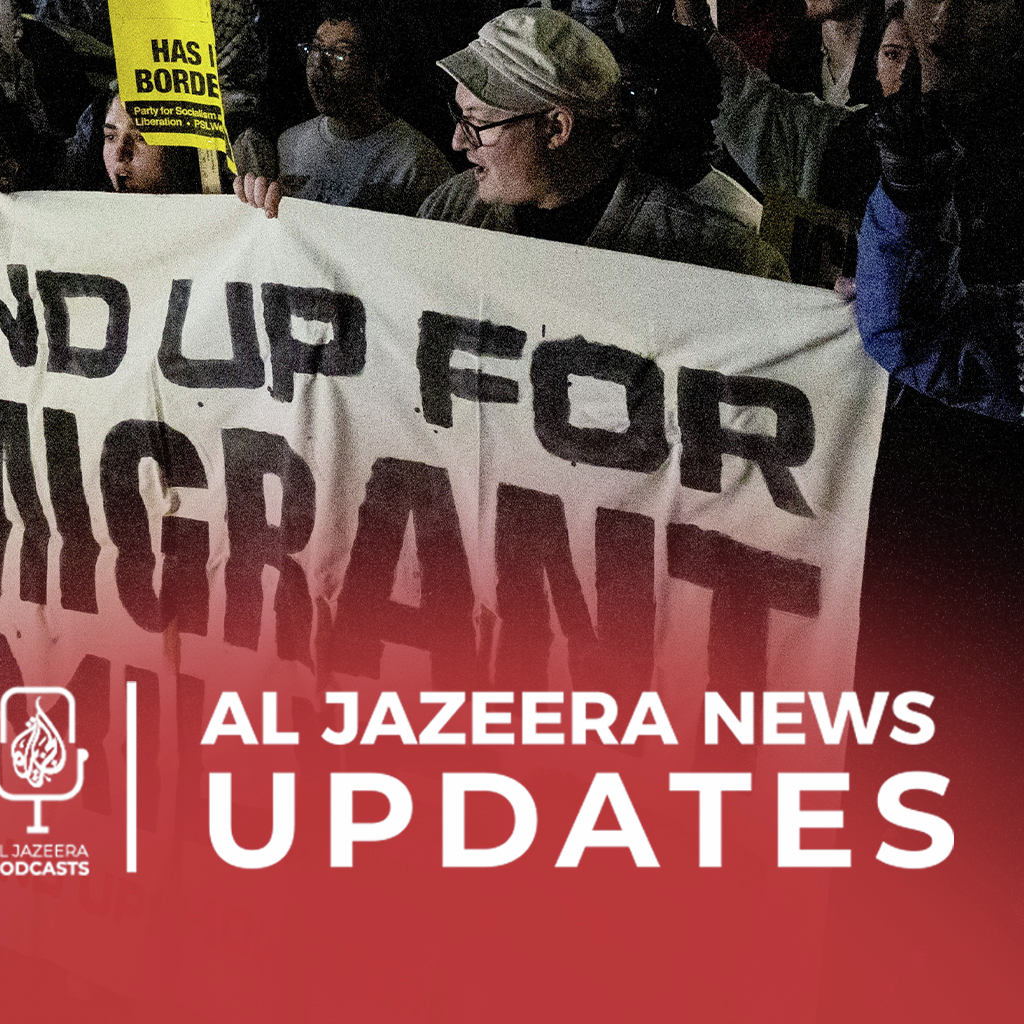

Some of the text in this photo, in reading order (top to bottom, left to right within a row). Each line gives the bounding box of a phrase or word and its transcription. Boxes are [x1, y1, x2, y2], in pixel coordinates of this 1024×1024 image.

[151, 38, 202, 66] HAS
[134, 68, 220, 100] BORDE
[134, 107, 159, 117] Party
[160, 107, 174, 116] for
[175, 107, 218, 120] Socialism
[135, 117, 183, 127] Liberation
[156, 278, 367, 403] UP
[415, 309, 818, 519] FOR
